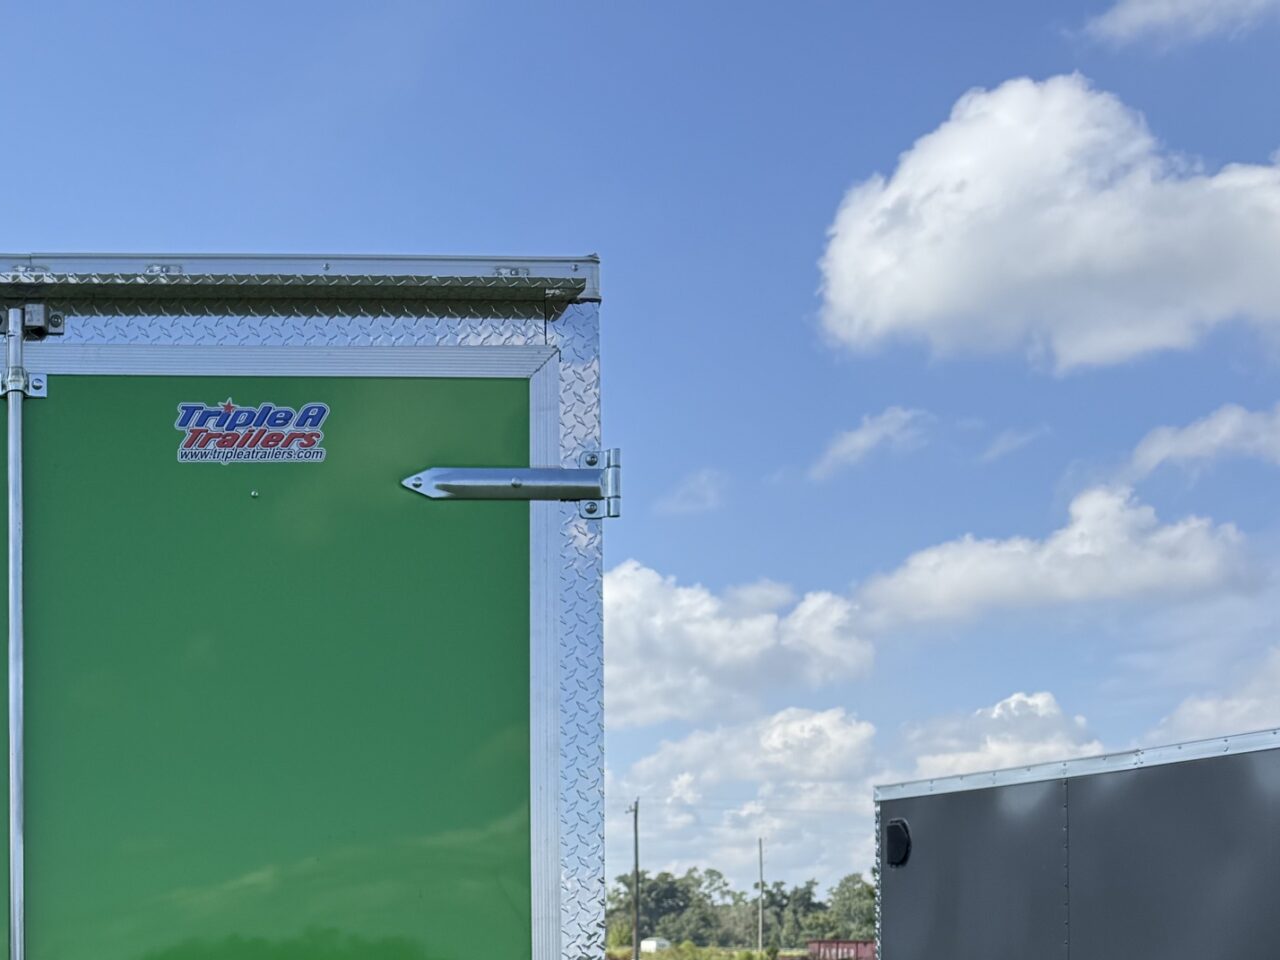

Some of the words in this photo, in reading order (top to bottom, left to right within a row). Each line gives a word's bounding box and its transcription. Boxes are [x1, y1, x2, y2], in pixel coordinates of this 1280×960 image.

[178, 403, 294, 431] Triple
[295, 405, 327, 427] A
[184, 428, 321, 448] Trailers
[180, 449, 323, 462] www.tripleatrailers.com
